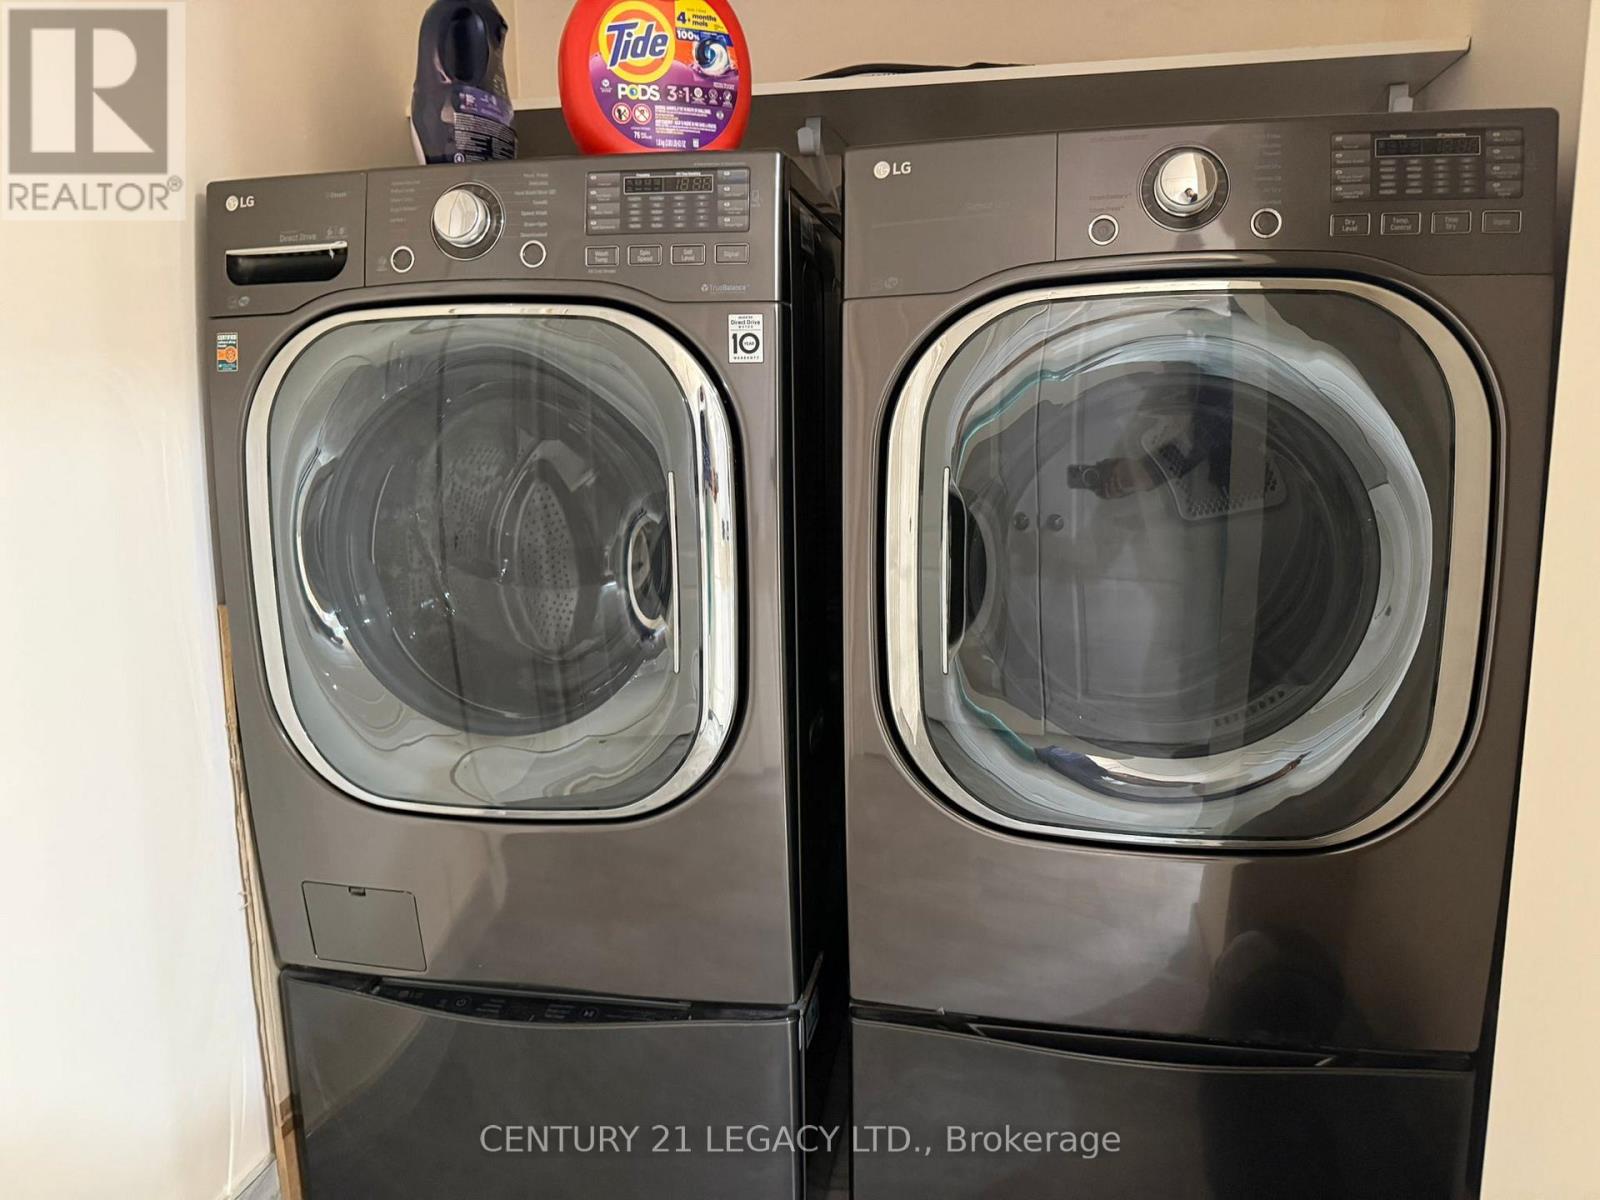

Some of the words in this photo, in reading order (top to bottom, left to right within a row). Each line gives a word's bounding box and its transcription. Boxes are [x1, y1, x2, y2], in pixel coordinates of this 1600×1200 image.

[692, 14, 717, 22] months
[677, 30, 700, 41] 100%
[607, 20, 669, 68] Tide
[617, 83, 660, 101] PODS
[893, 162, 912, 175] LG
[240, 196, 255, 208] LG
[732, 333, 760, 354] 10
